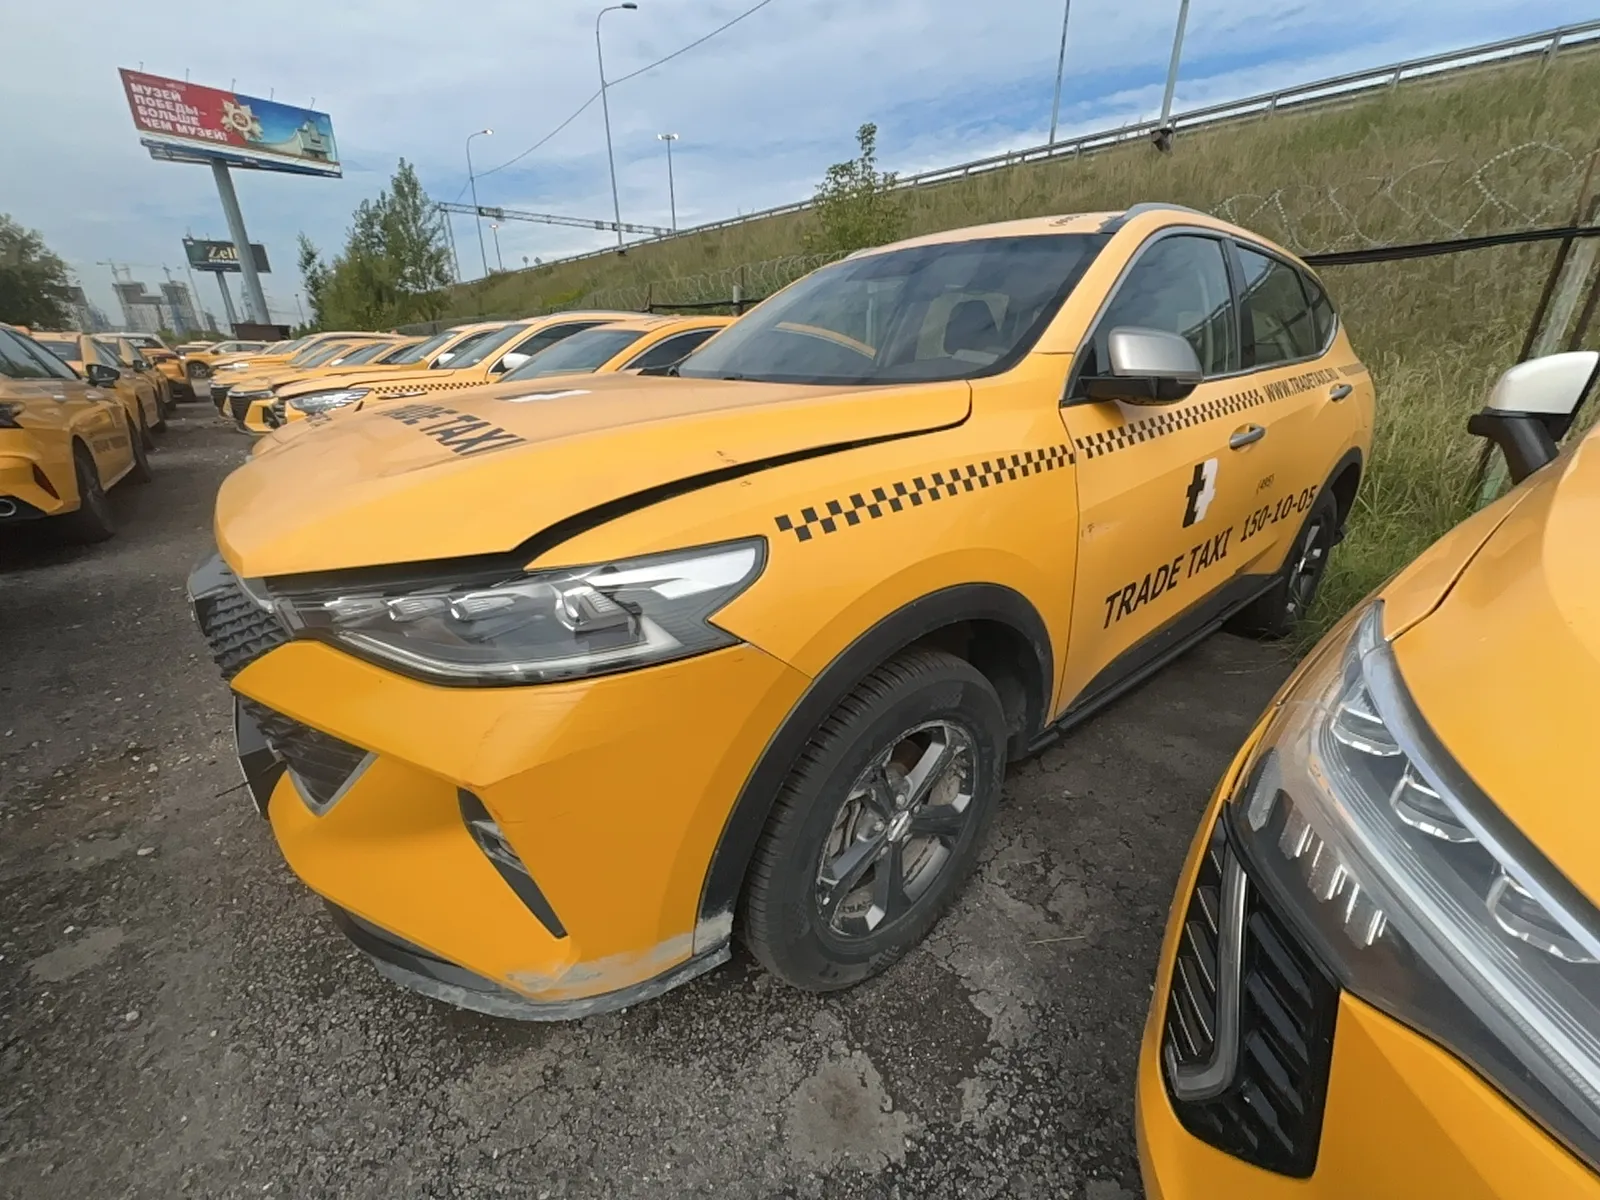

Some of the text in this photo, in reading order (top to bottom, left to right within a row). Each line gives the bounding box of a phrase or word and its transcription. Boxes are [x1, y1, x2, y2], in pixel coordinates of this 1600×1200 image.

[130, 82, 182, 102] МУЗЕЙ
[137, 105, 200, 127] БОЛЬШЕ
[140, 117, 228, 141] ЧЕМ МУЗЕЙ!
[419, 414, 527, 456] TAXI
[1103, 484, 1318, 629] TRADE TAXI 150-10-05
